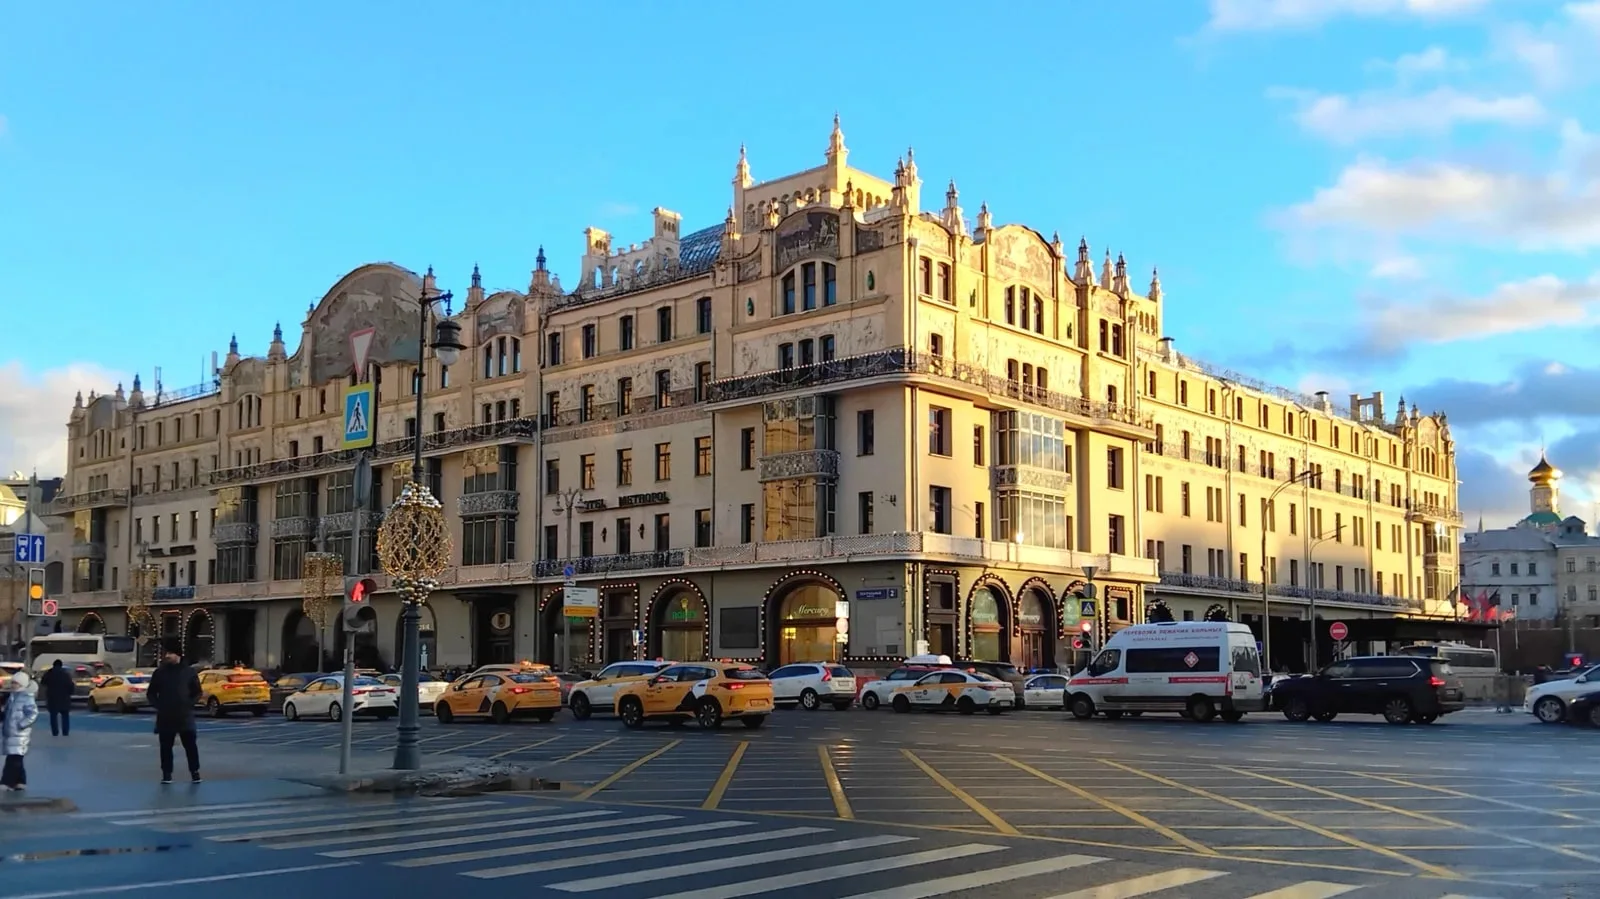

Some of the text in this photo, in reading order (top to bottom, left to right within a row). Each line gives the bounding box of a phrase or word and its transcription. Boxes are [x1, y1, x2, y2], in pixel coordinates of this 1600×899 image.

[579, 492, 669, 510] TEL METROPOL
[798, 604, 829, 617] Mercury
